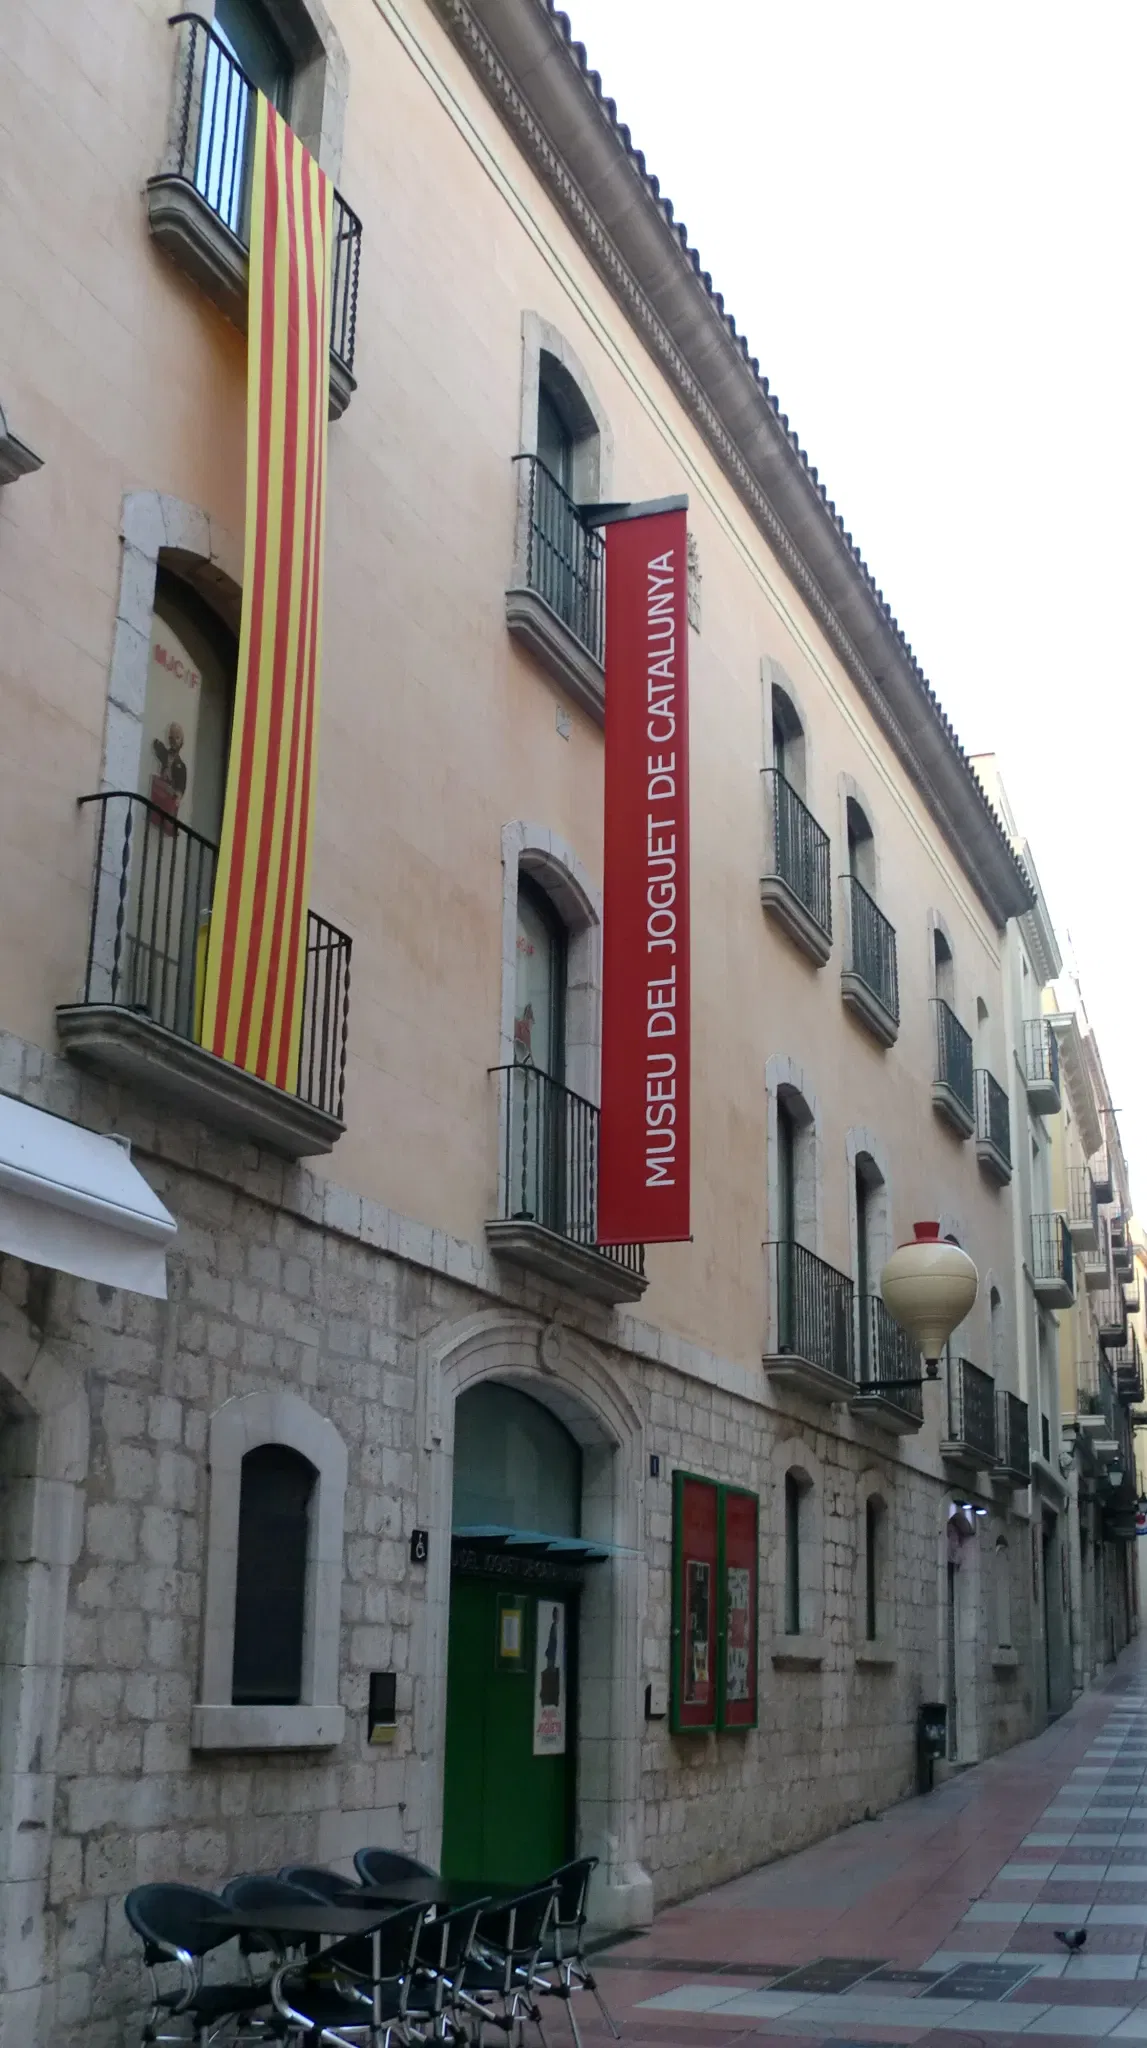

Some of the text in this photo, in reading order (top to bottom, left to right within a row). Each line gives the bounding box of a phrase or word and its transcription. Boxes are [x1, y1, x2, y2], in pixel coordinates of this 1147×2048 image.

[645, 549, 677, 1188] MUSEU DEL JOGUET DE CATALUNYA
